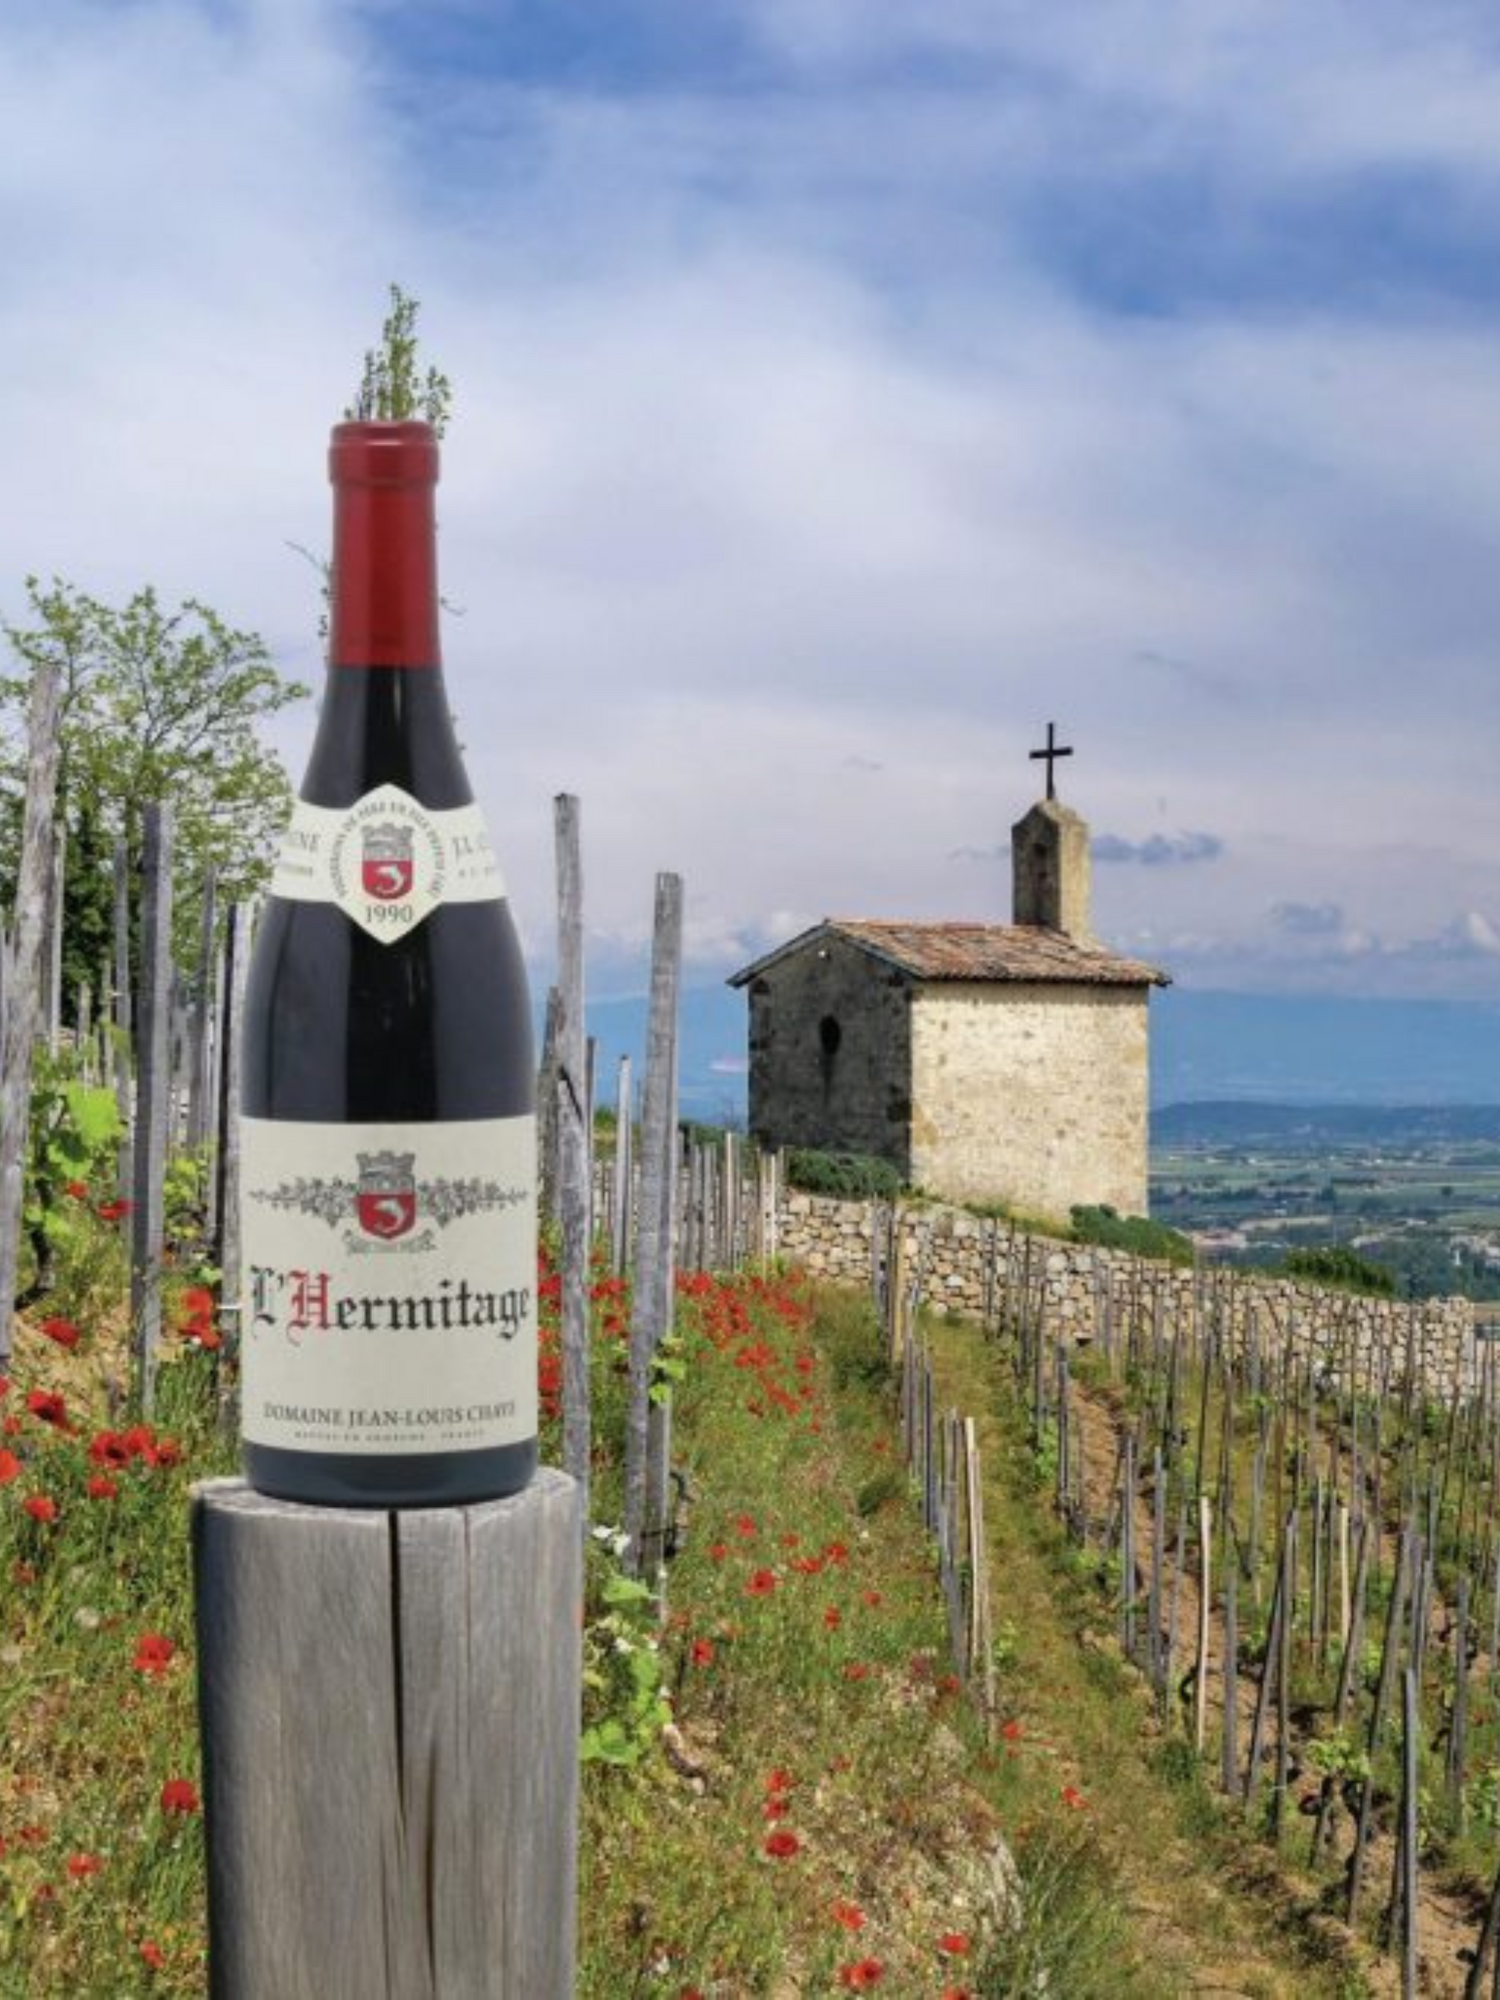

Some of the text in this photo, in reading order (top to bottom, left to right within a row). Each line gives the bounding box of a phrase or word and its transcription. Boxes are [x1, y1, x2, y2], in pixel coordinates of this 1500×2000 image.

[365, 904, 413, 923] 1990
[250, 1264, 530, 1346] L'Hermitage
[263, 1401, 345, 1426] DOMAINE
[349, 1405, 463, 1428] JEAN-LOUIS
